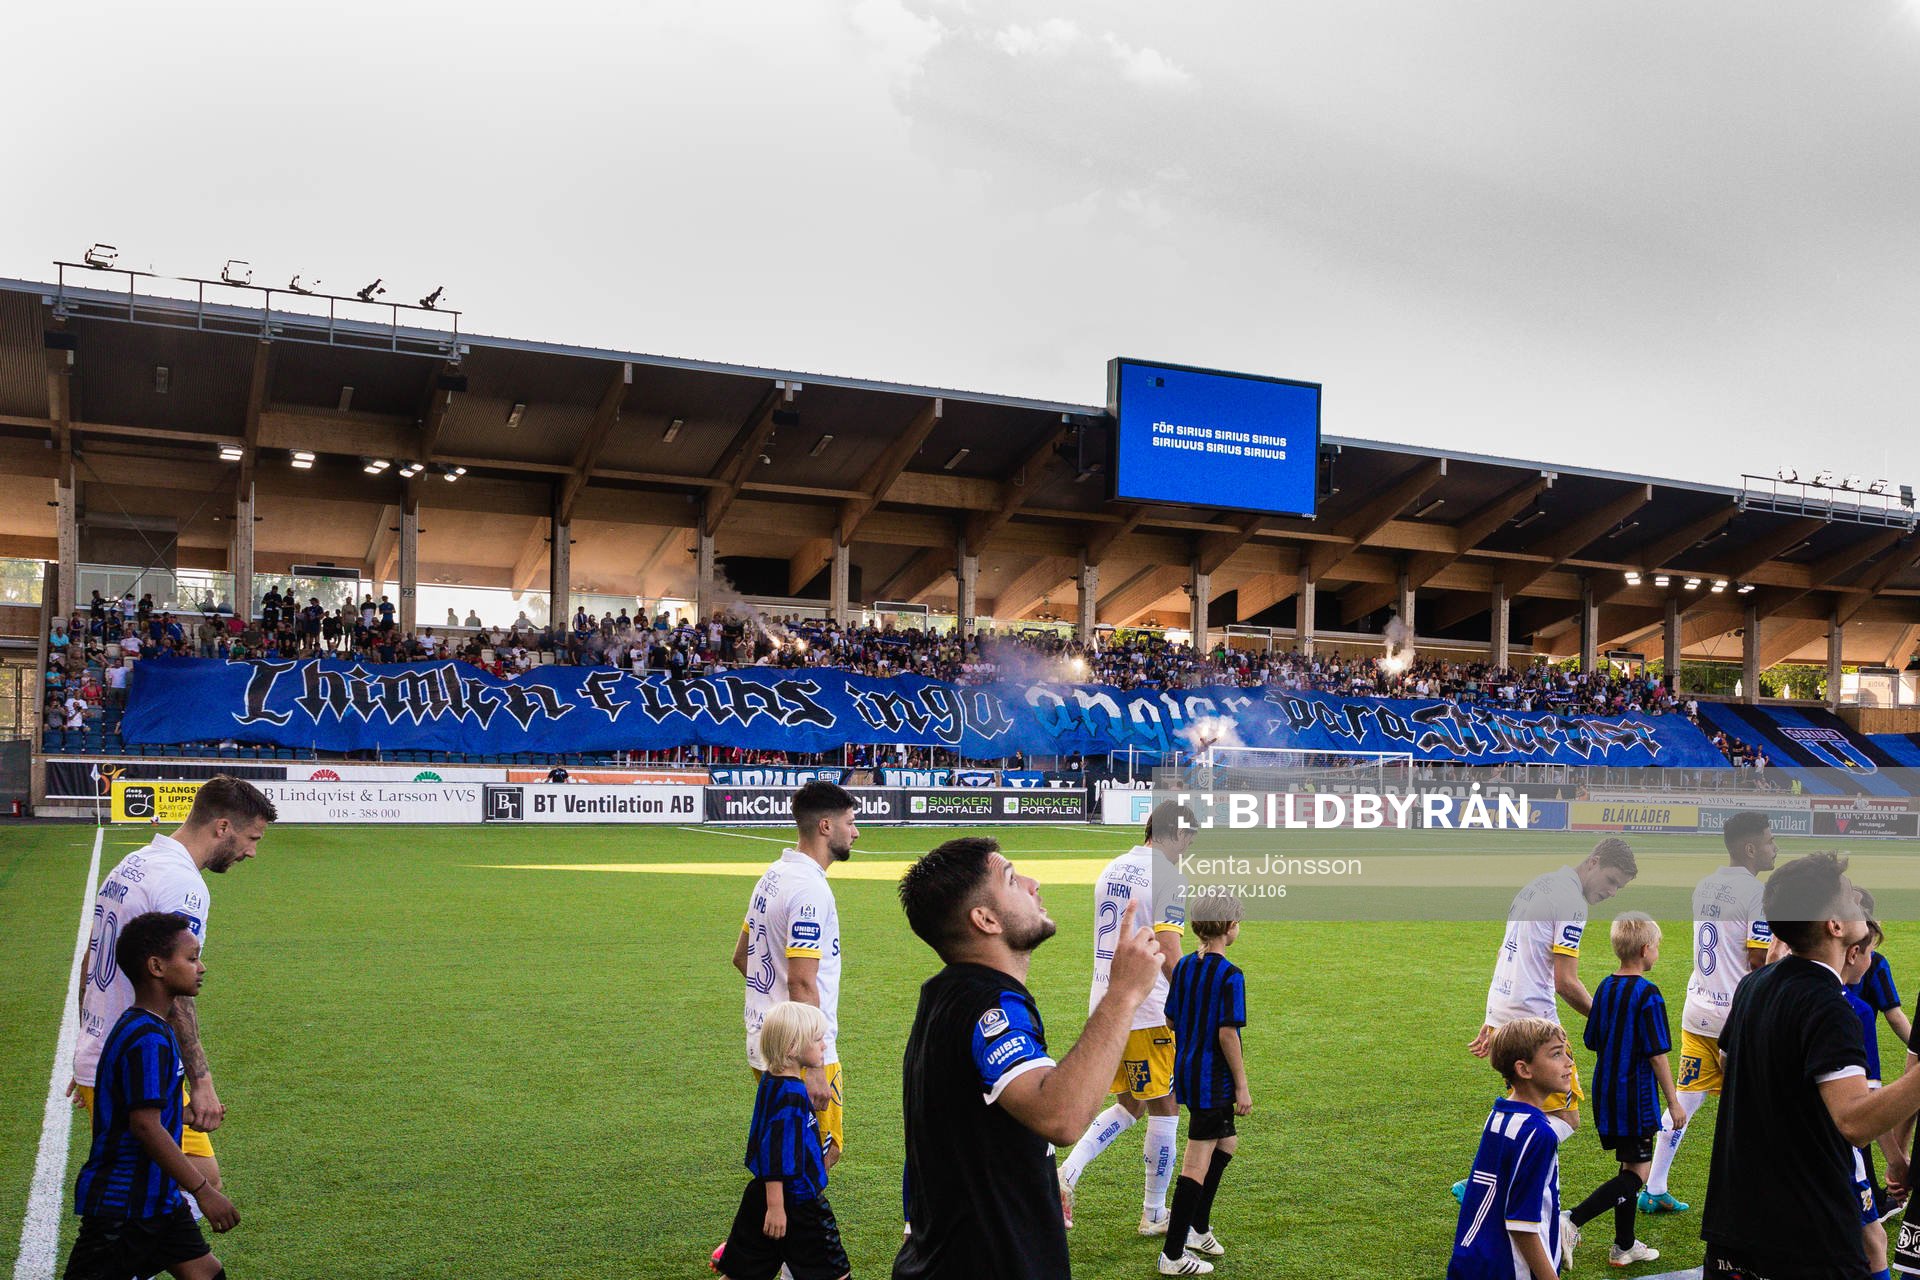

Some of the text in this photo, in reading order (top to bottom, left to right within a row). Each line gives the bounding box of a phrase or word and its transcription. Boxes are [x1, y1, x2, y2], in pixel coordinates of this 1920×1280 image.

[1176, 425, 1213, 438] SIRIUS
[1215, 429, 1250, 443] SIRIUS
[1252, 434, 1287, 447] SIRIUS
[1152, 437, 1286, 460] SIRIUUUS SIRIUS SIRIUUS
[403, 588, 415, 597] 22
[965, 618, 974, 626] 21
[1785, 728, 1842, 741] SIRIUS
[279, 788, 355, 806] Lindqvist
[360, 789, 373, 802] &
[378, 789, 437, 803] Larsson
[443, 789, 476, 803] VVS
[534, 794, 695, 814] BT Ventilation AB
[928, 796, 993, 806] SNICKERI
[1020, 797, 1082, 807] SNICKERI
[328, 808, 348, 818] 018
[359, 808, 379, 818] 388
[381, 808, 401, 819] 000
[928, 805, 993, 814] PORTALEN
[1020, 806, 1082, 815] PORTALEN
[1602, 806, 1671, 824] BLÅKLÄDER
[1834, 812, 1852, 820] TEAM
[1106, 882, 1132, 900] THERN
[1701, 903, 1721, 919] AIESH
[794, 925, 820, 934] UNIBET
[1697, 921, 1719, 977] 8
[987, 1035, 1027, 1065] UNIBET
[1461, 1169, 1498, 1248] 7
